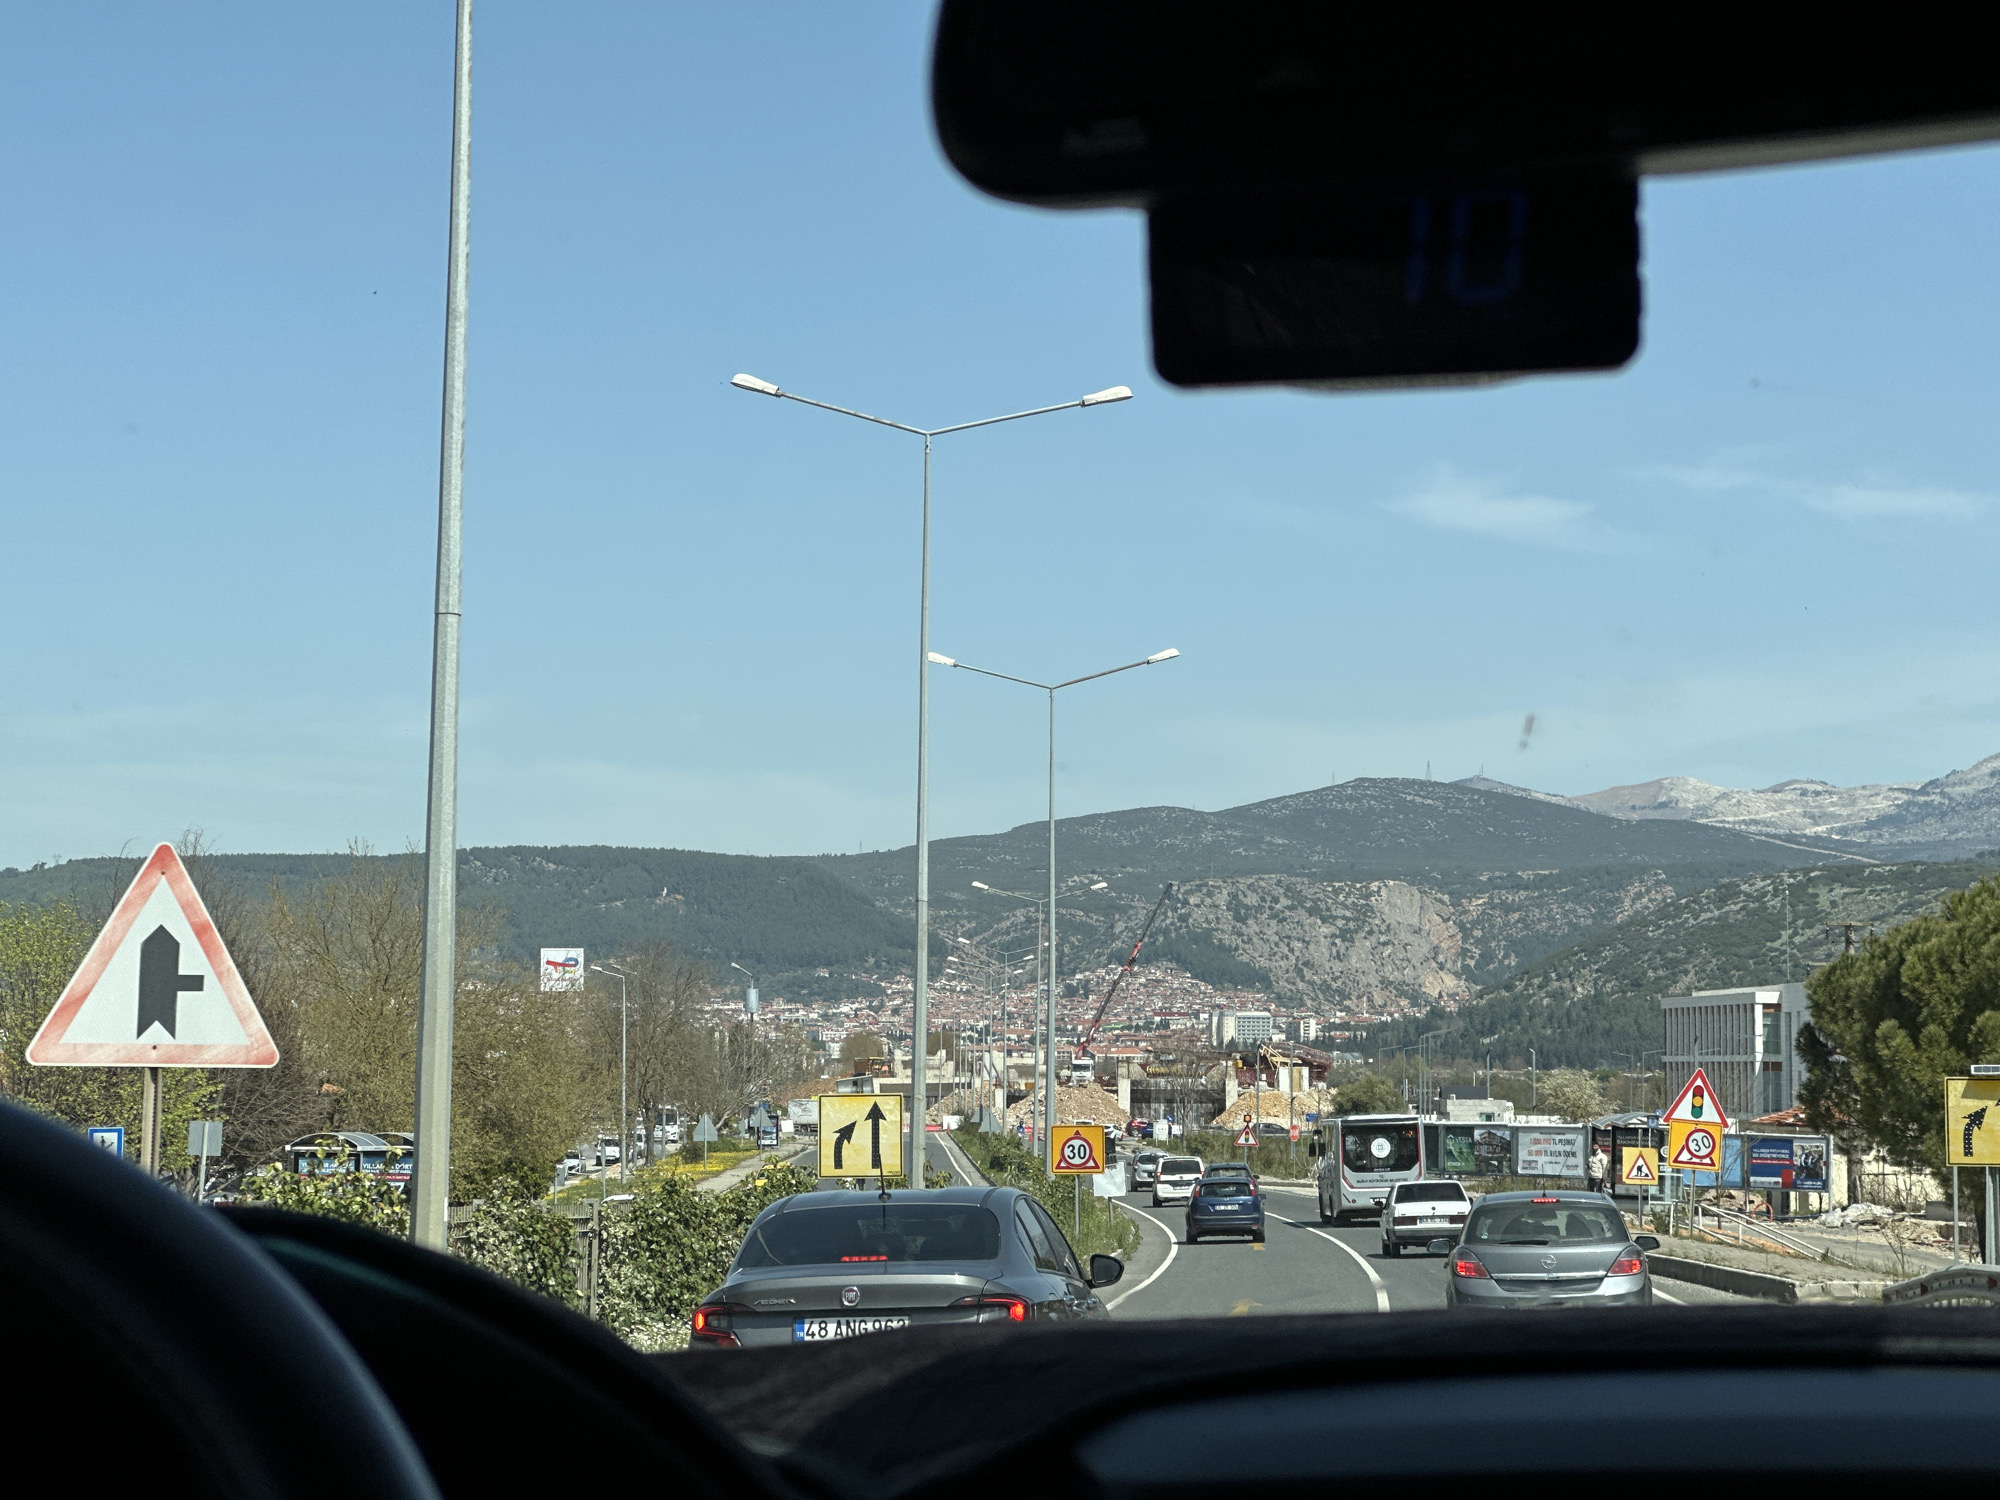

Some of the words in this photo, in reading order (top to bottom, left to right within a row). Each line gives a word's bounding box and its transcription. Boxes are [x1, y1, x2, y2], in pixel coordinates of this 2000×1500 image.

[1067, 1144, 1087, 1160] 30
[1691, 1135, 1711, 1153] 30
[845, 1291, 857, 1302] FIAT
[805, 1320, 829, 1339] 48
[834, 1319, 868, 1338] ANG
